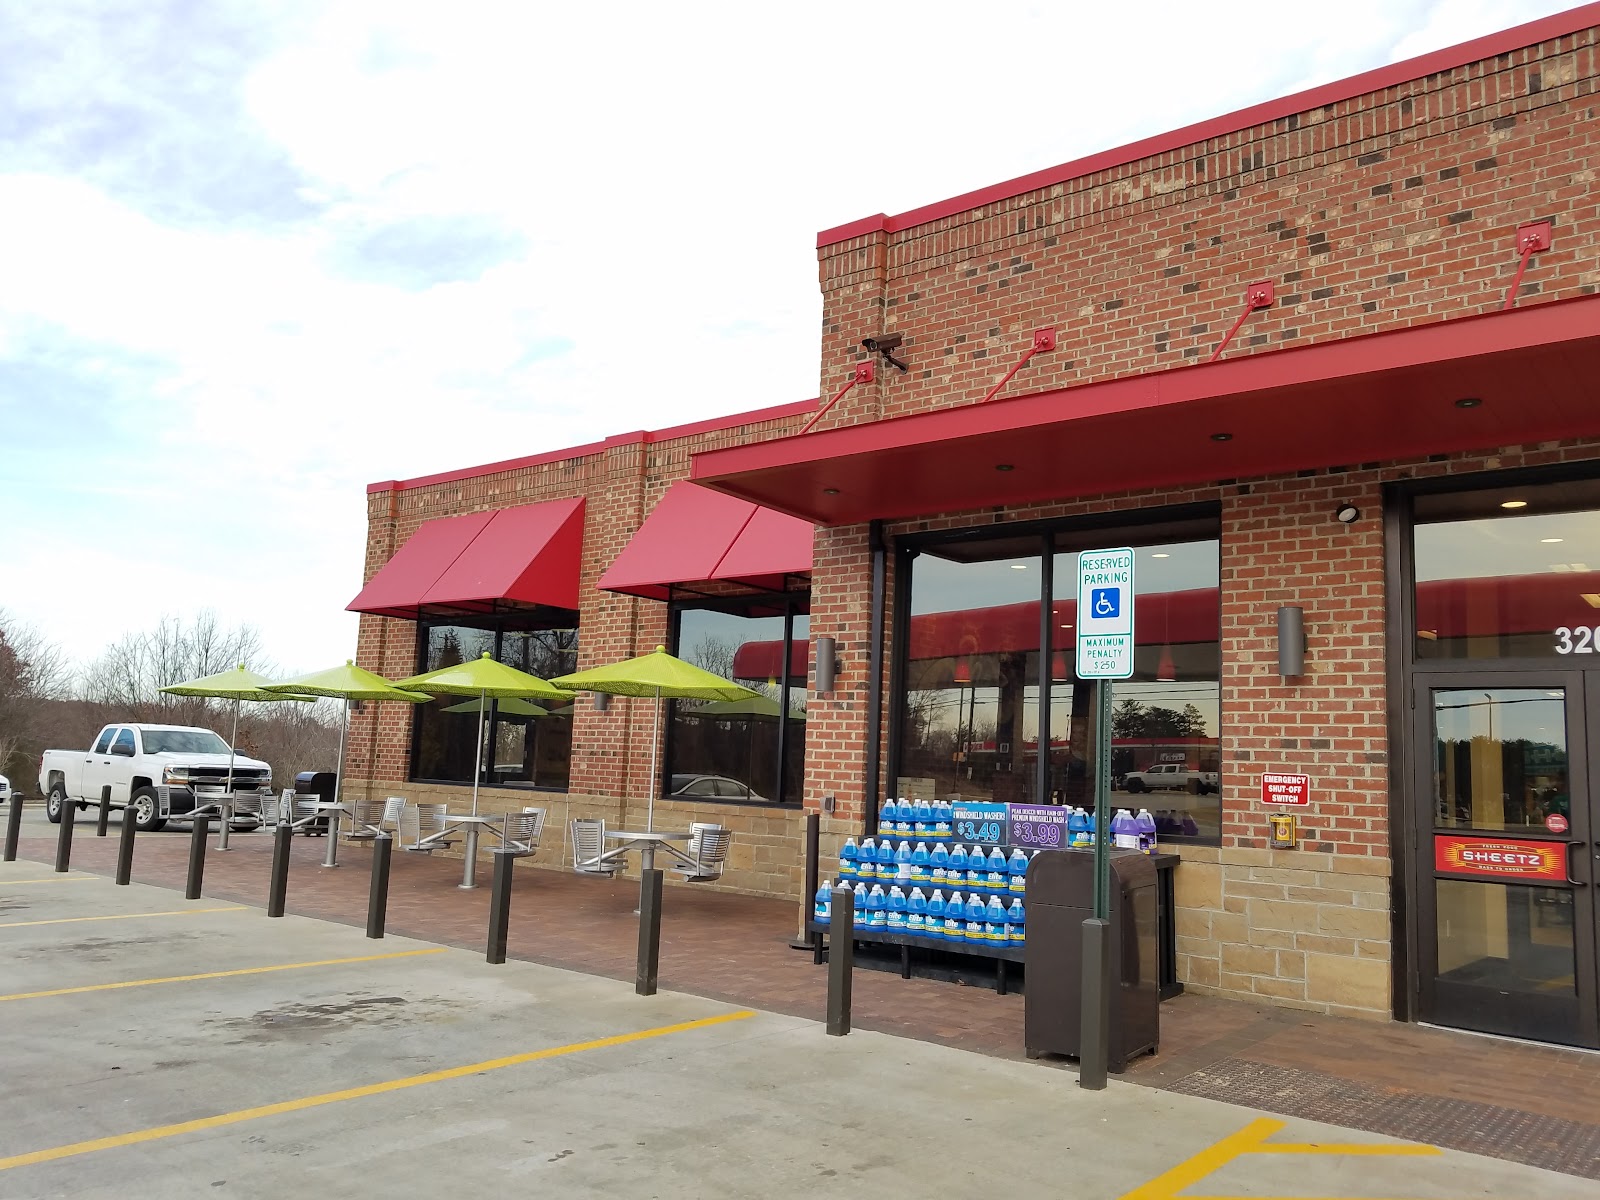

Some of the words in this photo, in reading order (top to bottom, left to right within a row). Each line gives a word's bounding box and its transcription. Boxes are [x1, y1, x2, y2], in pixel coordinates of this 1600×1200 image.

[1082, 556, 1130, 571] RESERVED
[1084, 572, 1128, 585] PARKING
[1086, 638, 1124, 647] MAXIMUM
[1087, 649, 1123, 658] PENALTY
[1264, 775, 1306, 784] EMERGENCY
[1268, 785, 1302, 794] SHUT-OFF
[1271, 794, 1299, 803] SWITCH
[1052, 816, 1065, 824] WASH
[897, 821, 911, 829] Elite
[957, 821, 1000, 841] $3.49
[1013, 821, 1060, 844] $3.99
[1463, 851, 1540, 865] SHEETZ
[860, 862, 875, 870] Elite
[947, 869, 962, 878] Elite
[988, 871, 1003, 880] Elite
[944, 919, 959, 928] Elite
[966, 921, 982, 930] Elite
